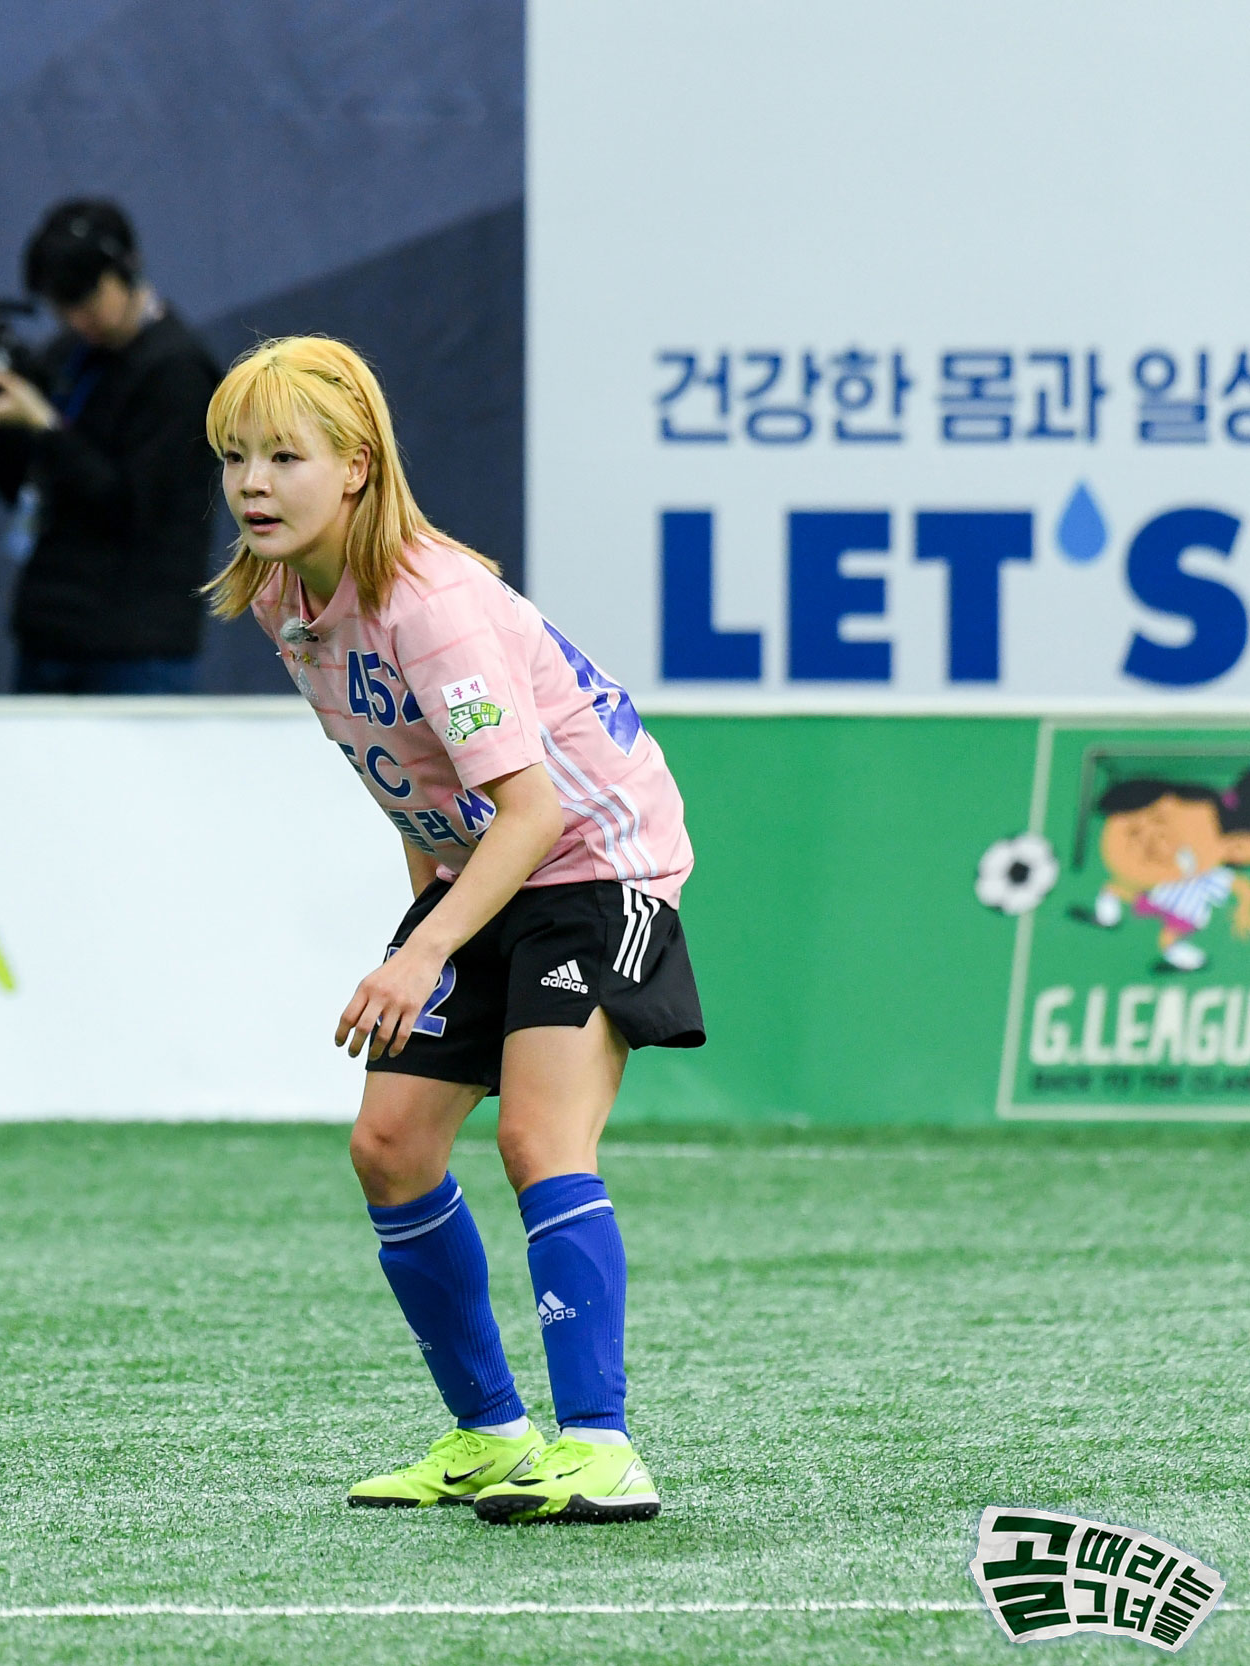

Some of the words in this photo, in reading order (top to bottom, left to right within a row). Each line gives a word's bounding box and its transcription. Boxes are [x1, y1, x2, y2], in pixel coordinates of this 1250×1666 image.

[654, 349, 912, 445] 건강한
[937, 348, 1108, 446] 몸과
[659, 478, 1249, 688] LET'S
[540, 976, 589, 994] adidas
